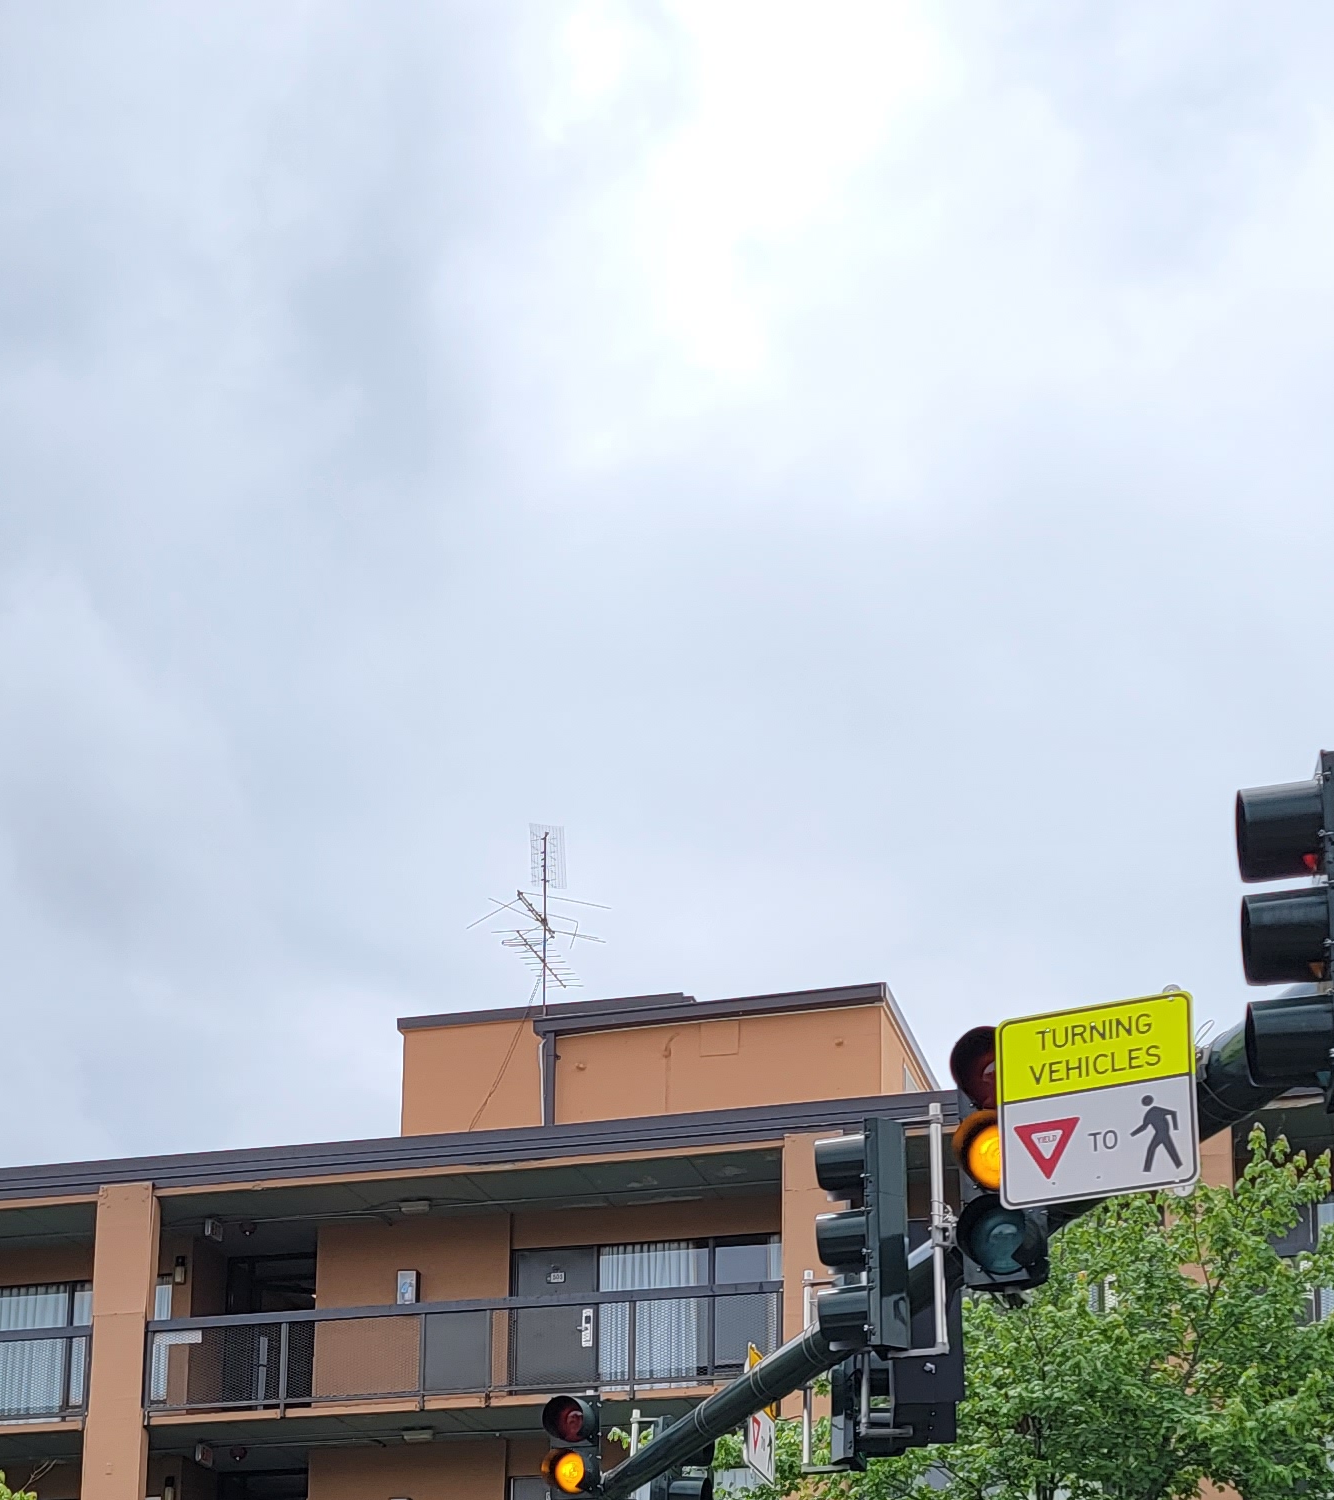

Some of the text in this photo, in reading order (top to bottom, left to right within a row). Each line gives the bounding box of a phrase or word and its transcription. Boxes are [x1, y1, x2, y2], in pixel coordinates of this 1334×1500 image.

[1035, 1013, 1153, 1051] TURNING
[1029, 1045, 1161, 1085] VEHICLES
[1037, 1134, 1057, 1144] YIELD
[1088, 1130, 1118, 1152] TO
